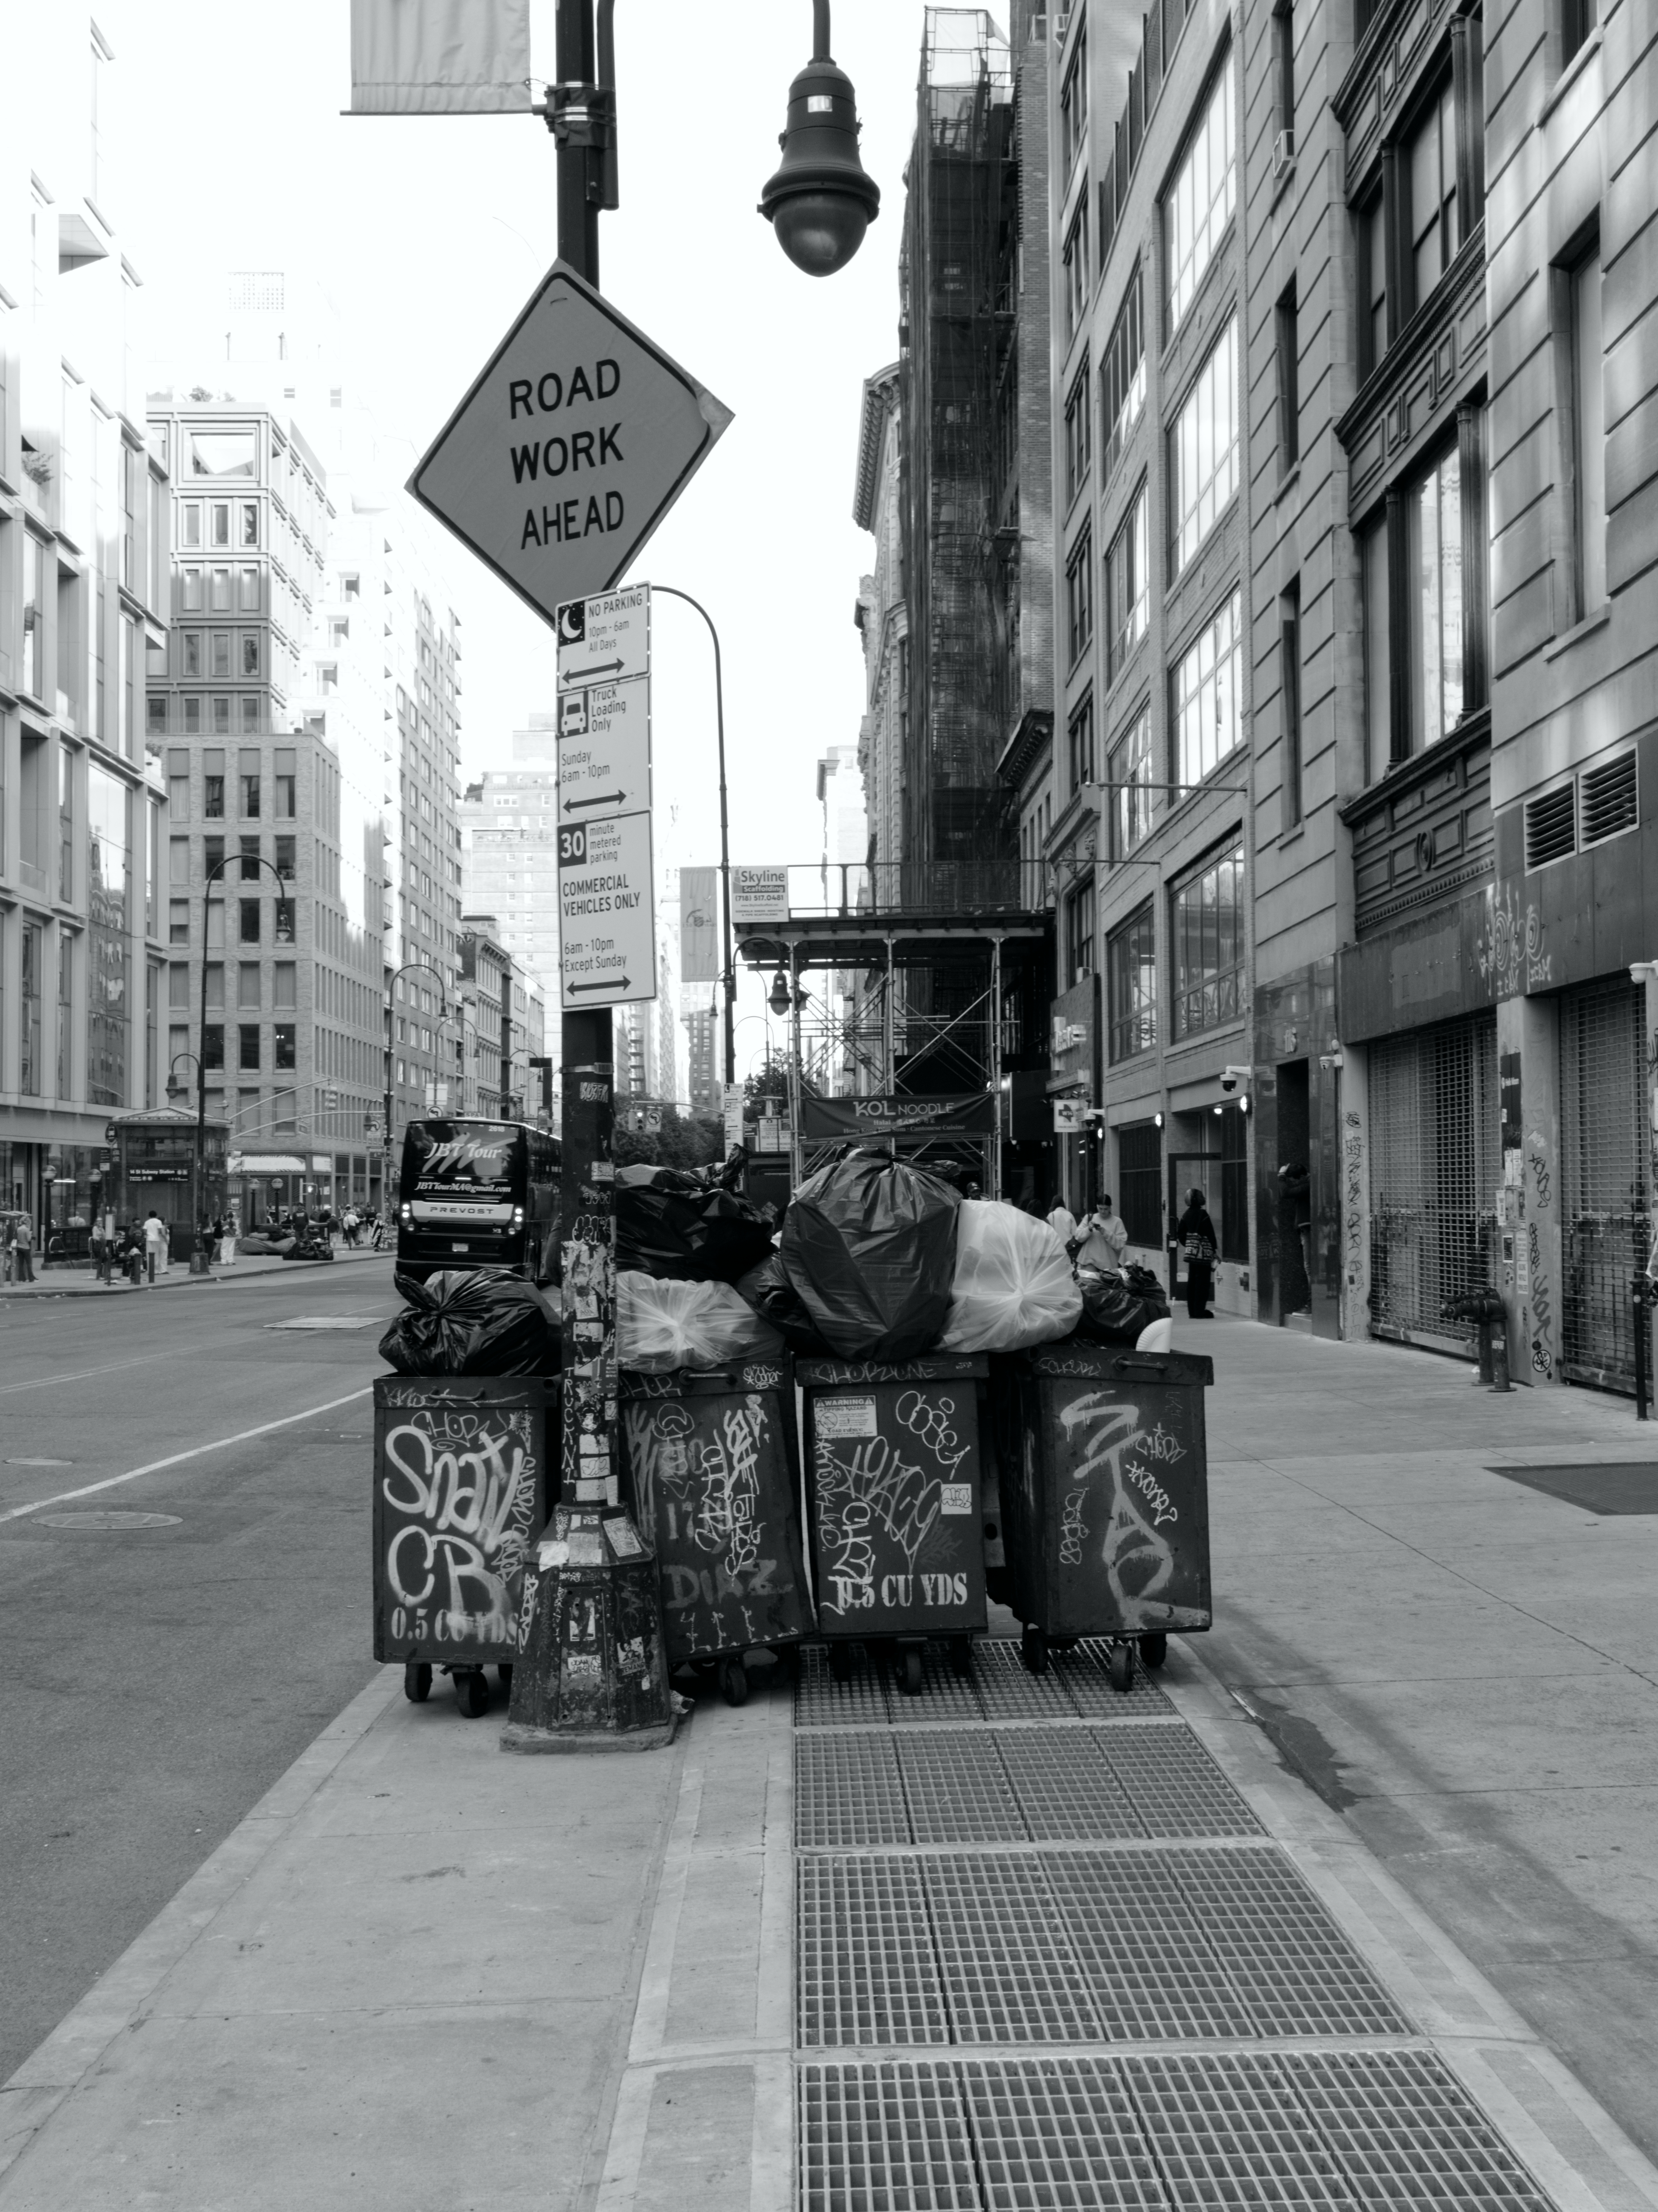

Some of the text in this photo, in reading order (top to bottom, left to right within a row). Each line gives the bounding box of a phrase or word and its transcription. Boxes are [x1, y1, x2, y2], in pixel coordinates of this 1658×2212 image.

[510, 359, 620, 420] ROAD
[510, 423, 623, 484] WORK
[521, 491, 623, 550] AHEAD
[589, 593, 642, 618] NO PARKING
[589, 625, 607, 638] 10pm
[614, 620, 629, 632] 6am
[589, 639, 617, 653] All Days
[592, 686, 617, 702] Truck
[592, 701, 626, 717] Loading
[592, 718, 611, 732] Only
[562, 750, 591, 766] Sunday
[562, 770, 579, 782] 6am
[588, 765, 610, 779] 10pm
[561, 823, 615, 858] 30 minute
[590, 835, 621, 850] metered
[591, 850, 618, 865] parking
[563, 874, 629, 897] COMMERCIAL
[741, 870, 784, 885] Skyline
[564, 892, 640, 917] VEHICLES ONLY
[565, 942, 582, 954] 6am
[591, 938, 614, 953] 10pm
[565, 954, 626, 973] Except Sunday
[853, 1100, 954, 1116] KOL NOODLE
[424, 1143, 502, 1158] JBT Tour
[882, 1574, 913, 1608] CU
[920, 1573, 967, 1605] YDS
